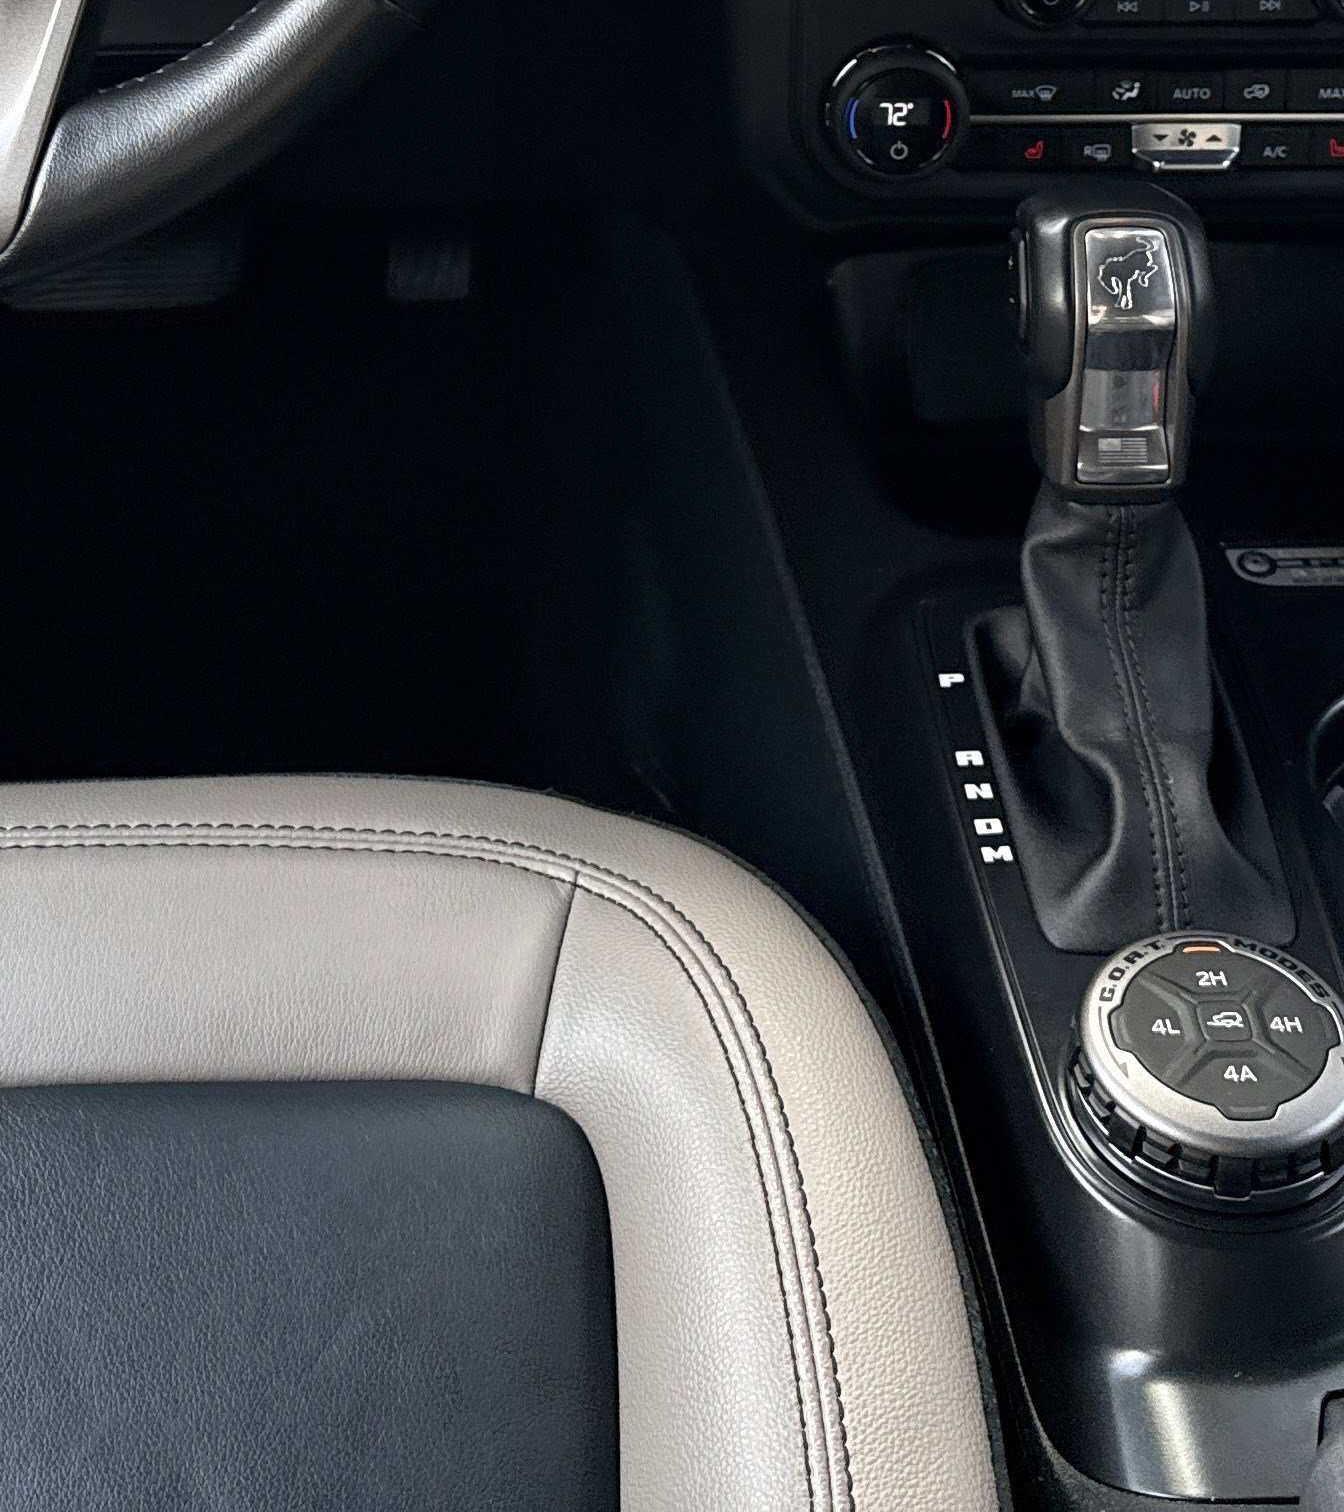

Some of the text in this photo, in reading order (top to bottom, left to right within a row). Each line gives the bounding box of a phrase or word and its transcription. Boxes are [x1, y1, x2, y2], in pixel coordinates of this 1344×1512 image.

[1011, 89, 1036, 99] MAX
[1172, 88, 1211, 100] AUTO
[1263, 145, 1288, 158] A/C
[938, 673, 965, 687] P
[964, 783, 994, 800] N
[980, 845, 1013, 862] M
[1232, 938, 1331, 1001] MODES
[1195, 971, 1227, 987] 2H
[1151, 1019, 1181, 1035] 4L
[1269, 1017, 1303, 1033] 4H
[1223, 1065, 1258, 1082] 4A
